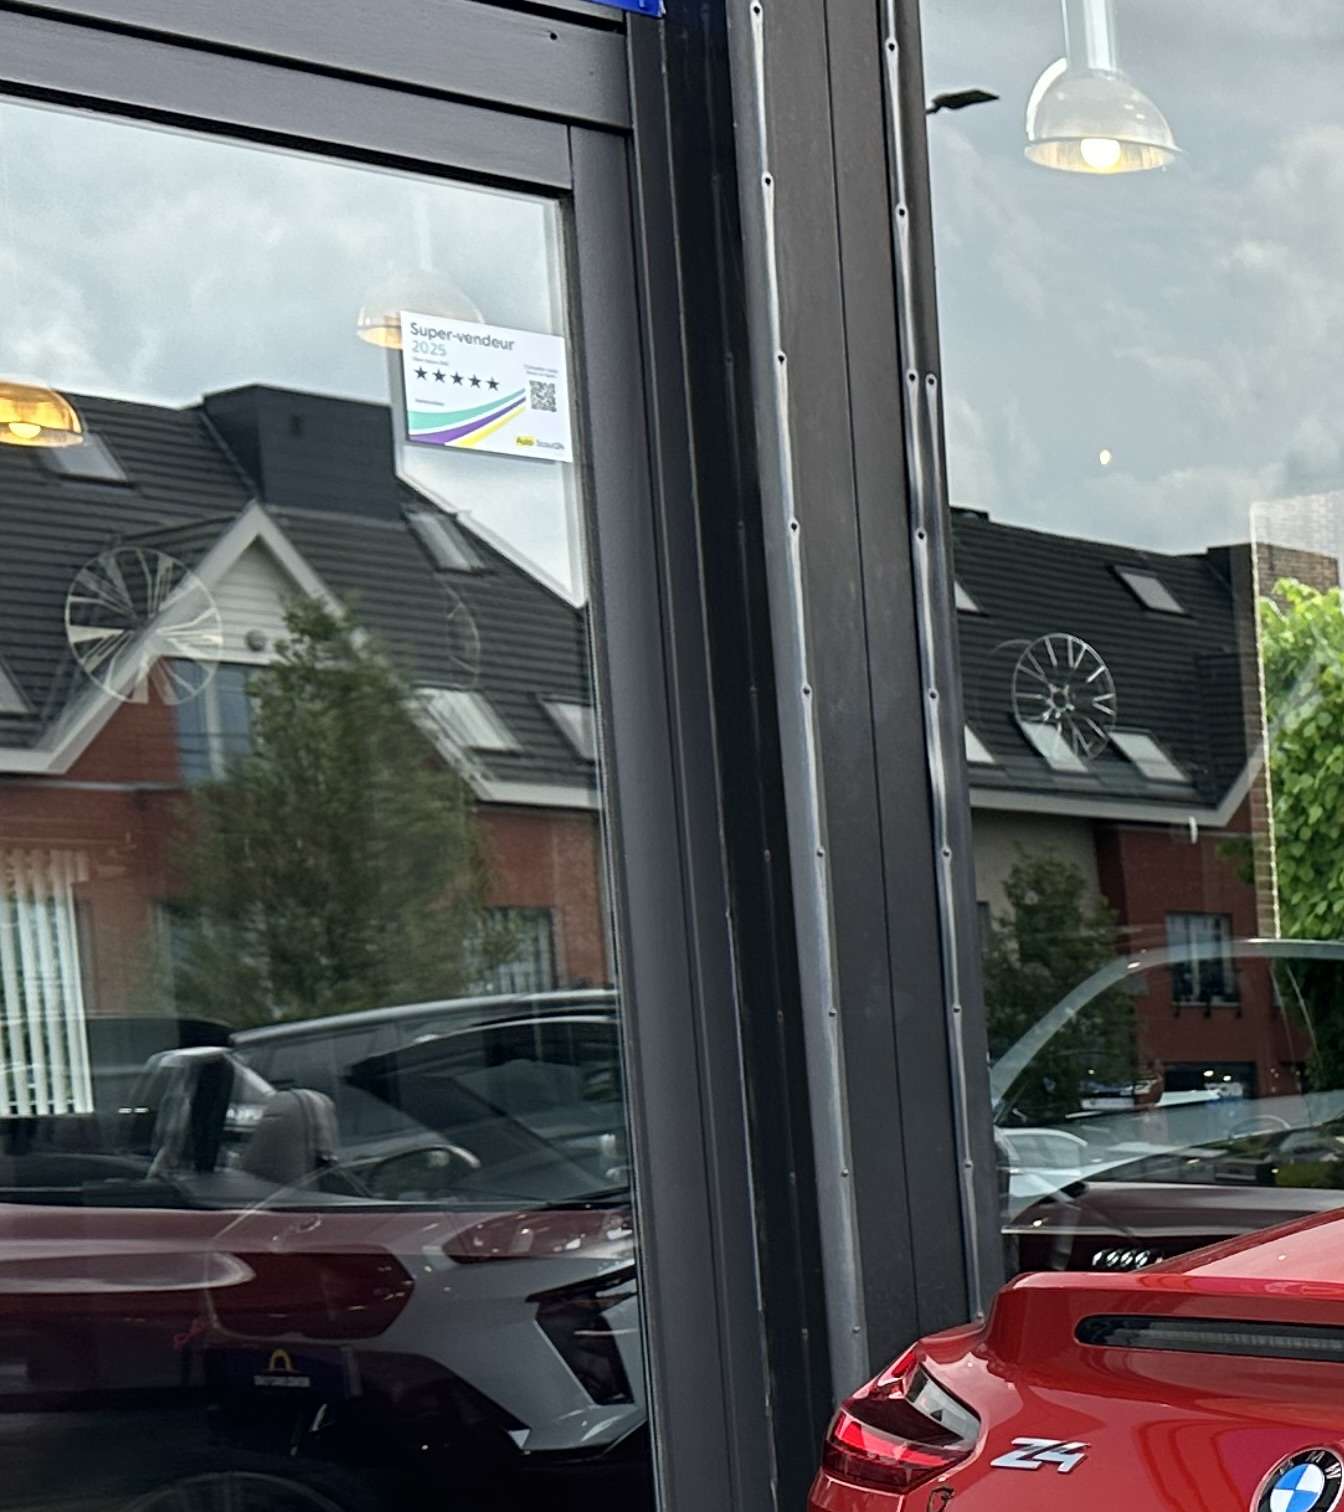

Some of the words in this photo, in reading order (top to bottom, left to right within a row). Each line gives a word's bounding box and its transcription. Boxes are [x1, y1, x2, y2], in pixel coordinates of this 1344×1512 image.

[410, 321, 515, 351] Super-vendeur
[411, 339, 447, 357] 2025
[989, 1435, 1092, 1473] Z4
